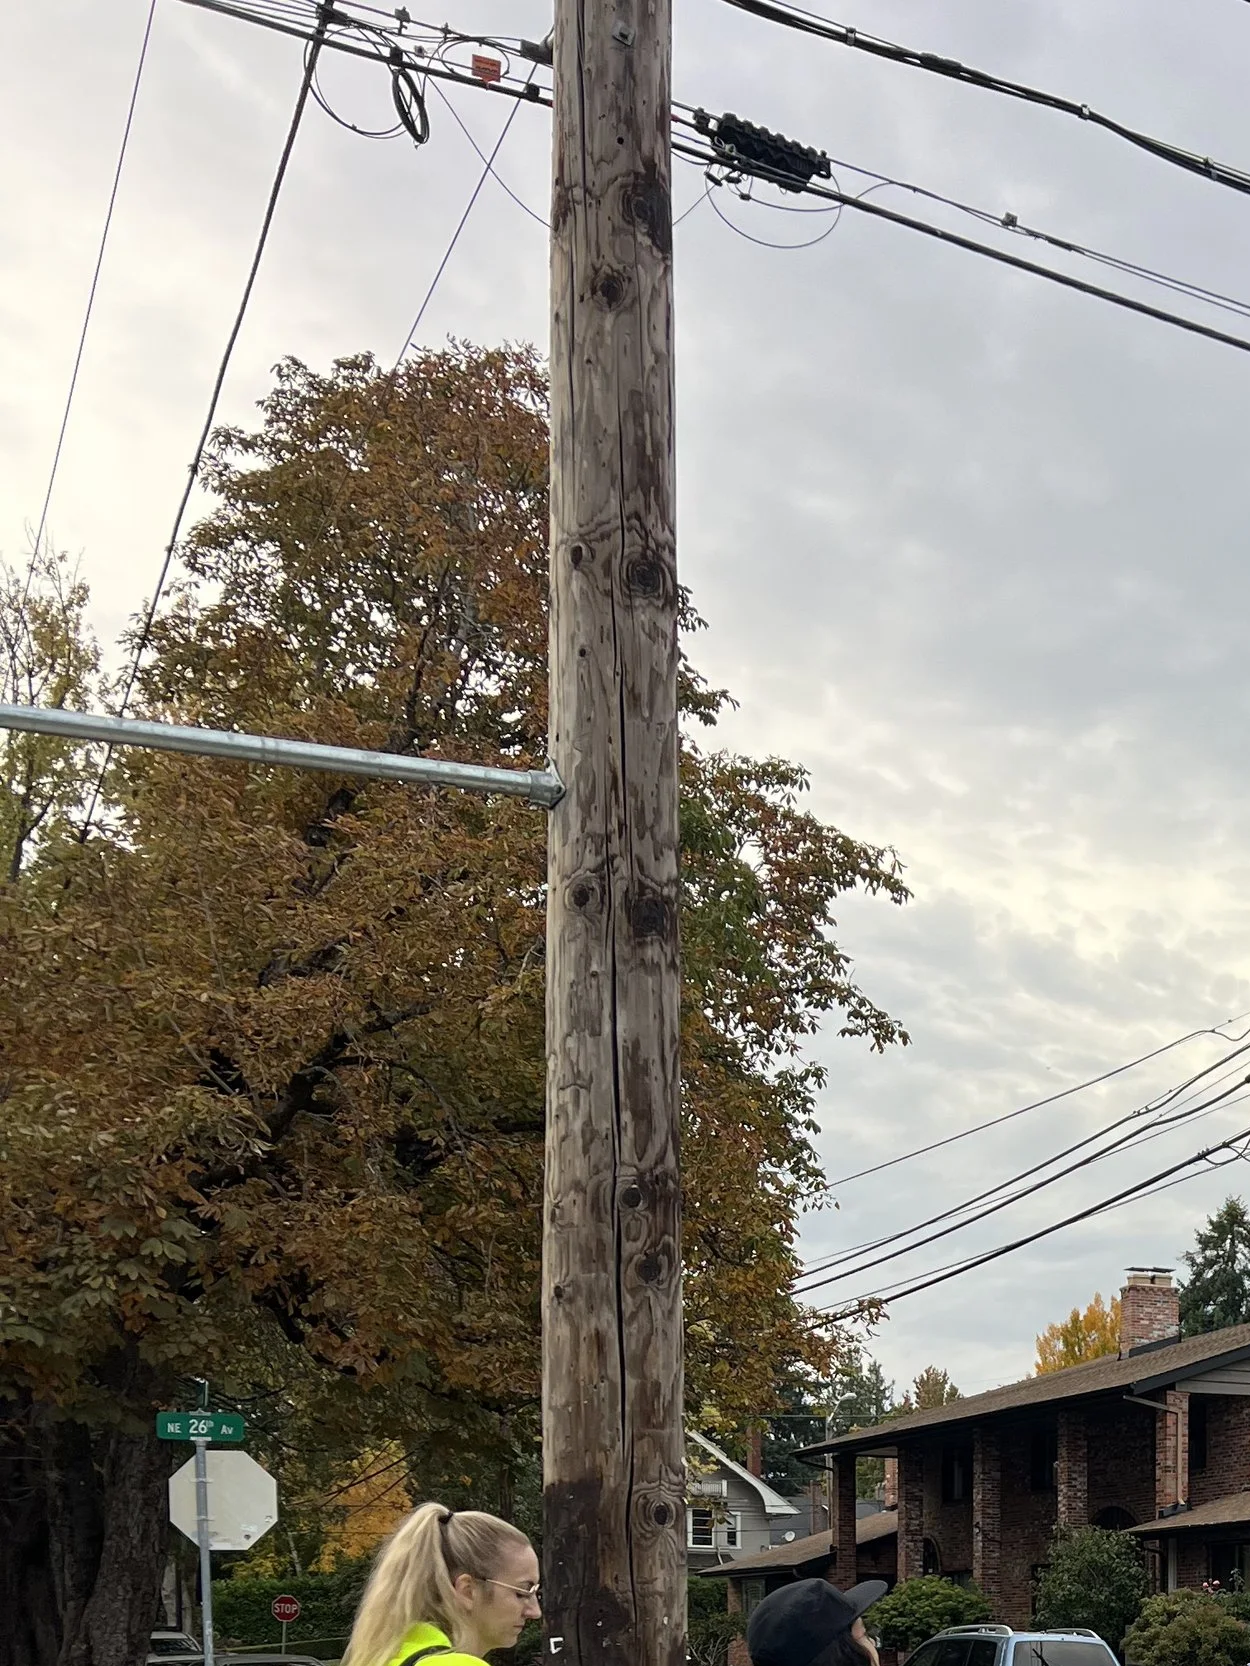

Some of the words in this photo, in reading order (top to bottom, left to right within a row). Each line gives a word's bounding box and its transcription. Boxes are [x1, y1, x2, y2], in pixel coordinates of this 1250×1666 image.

[167, 1422, 182, 1434] NE
[188, 1418, 214, 1434] 26th
[220, 1424, 234, 1435] Av
[273, 1603, 298, 1614] STOP
